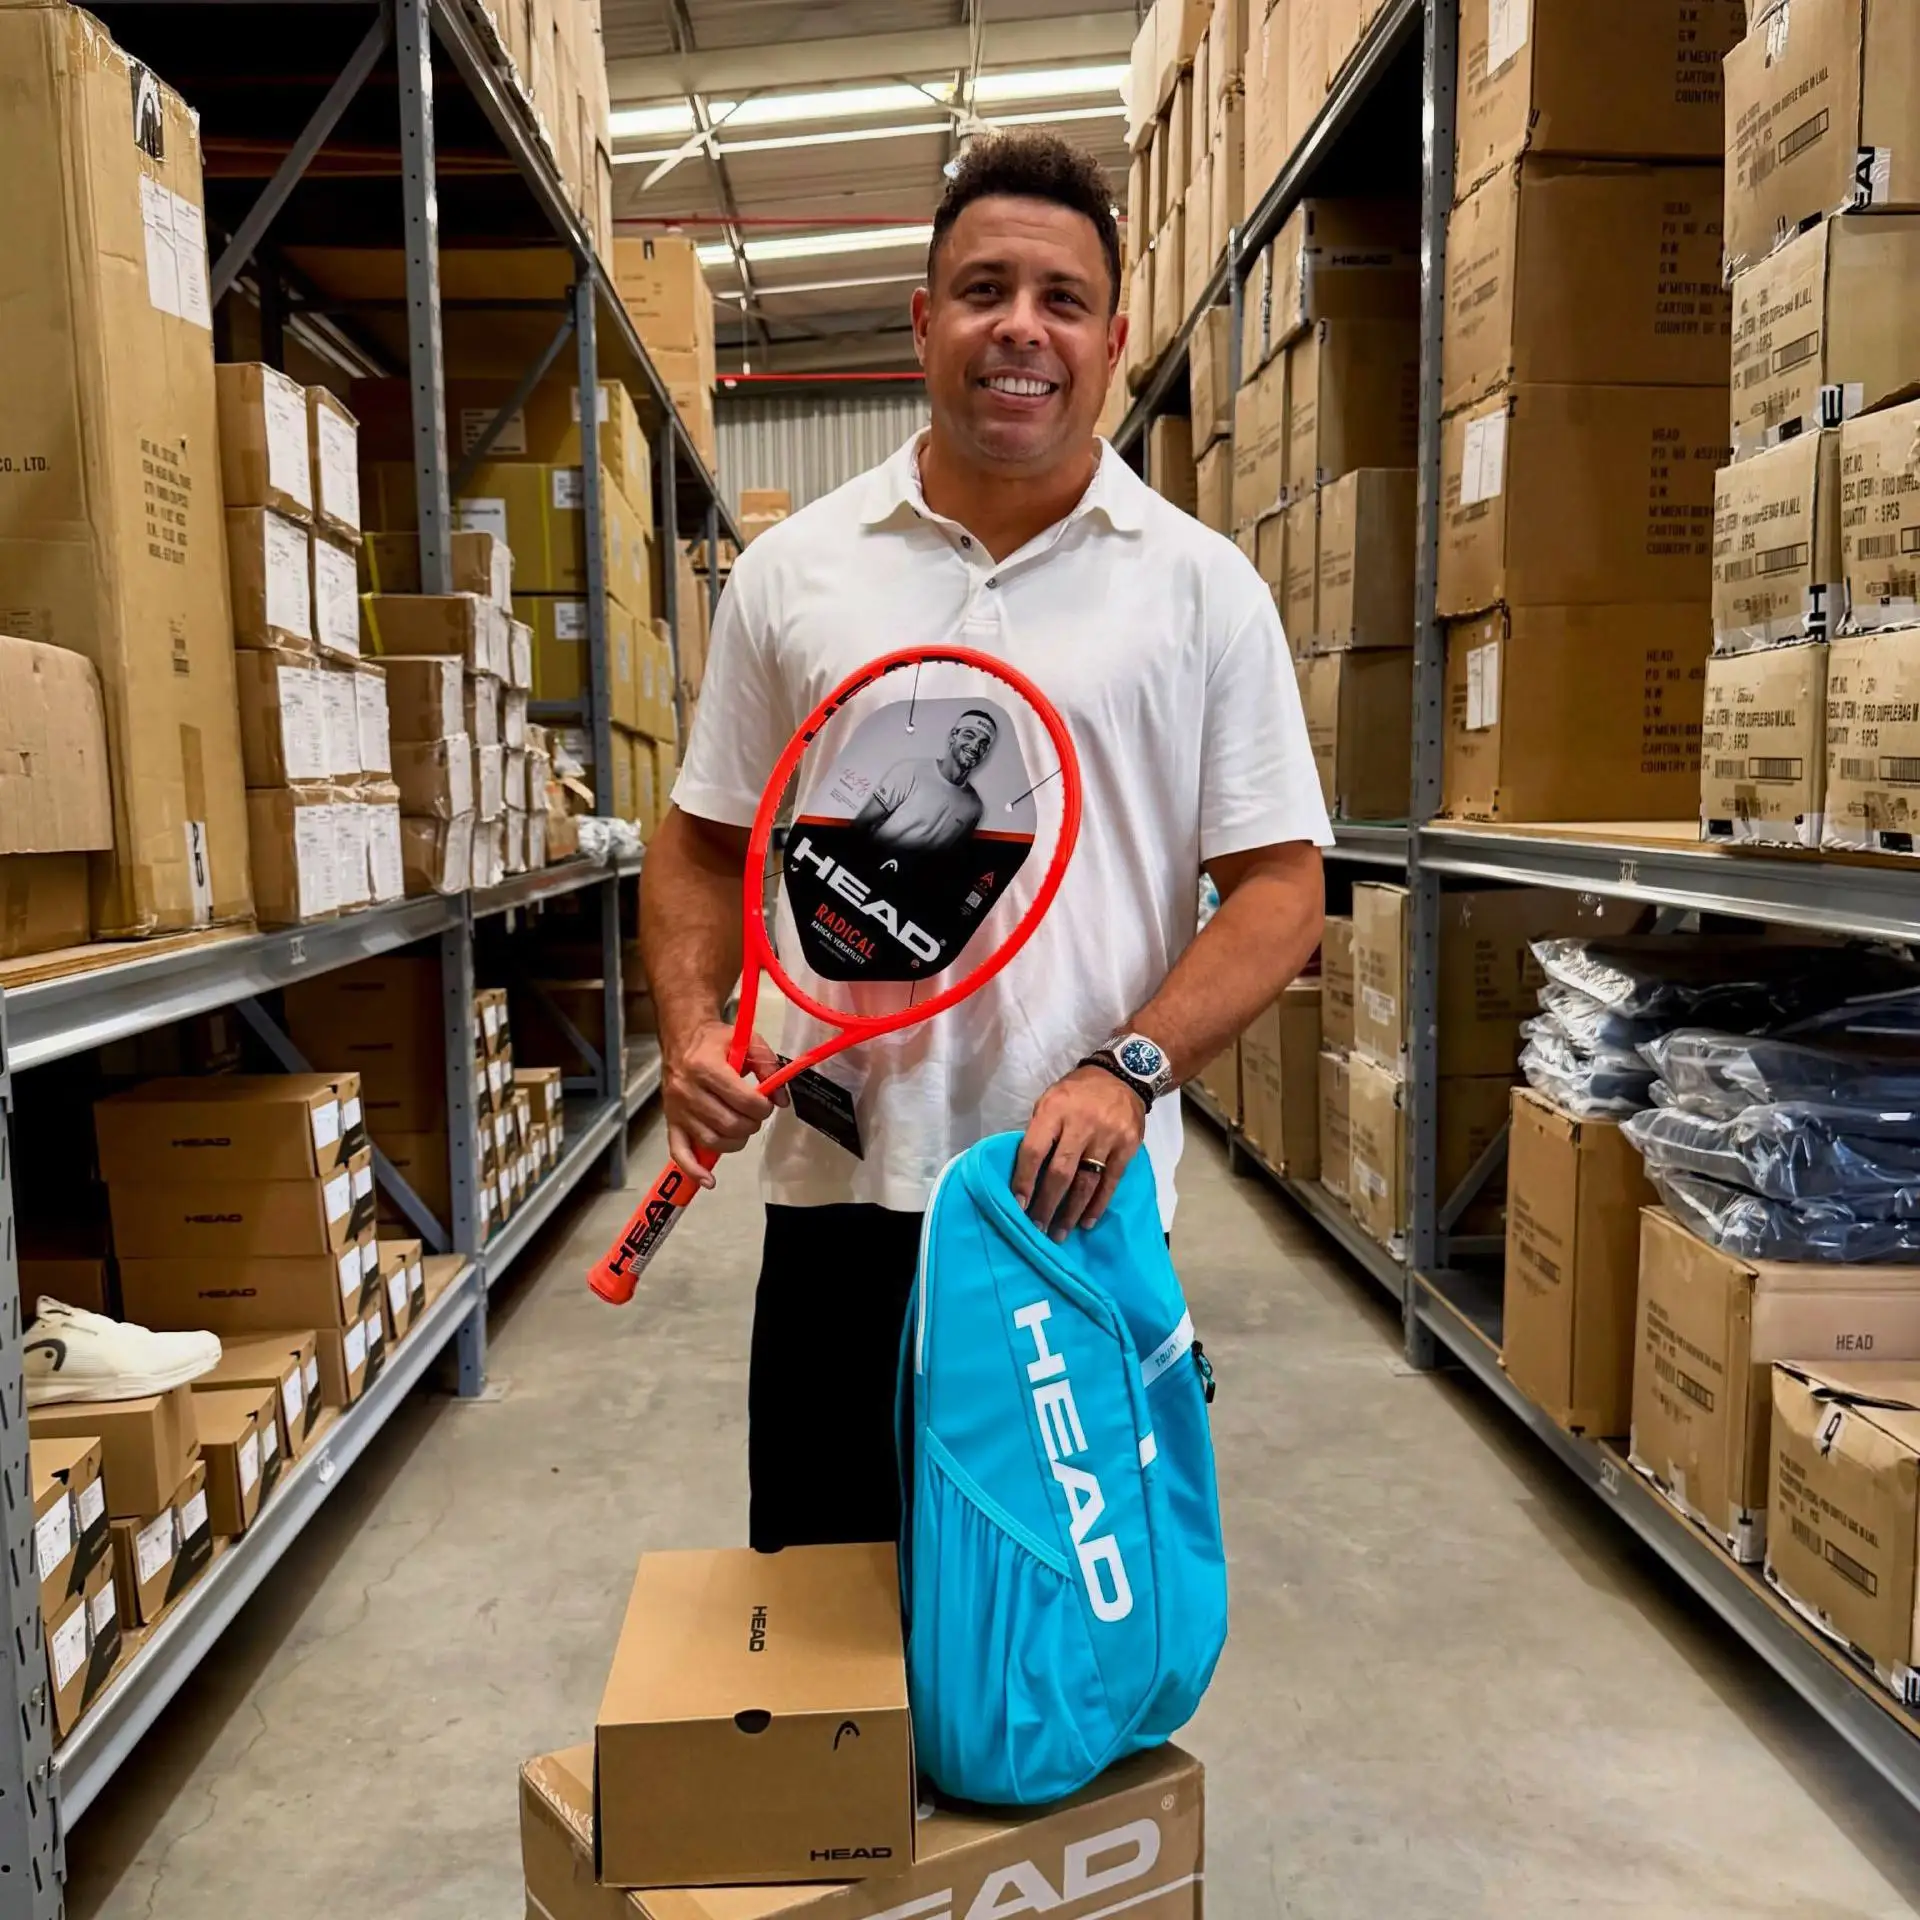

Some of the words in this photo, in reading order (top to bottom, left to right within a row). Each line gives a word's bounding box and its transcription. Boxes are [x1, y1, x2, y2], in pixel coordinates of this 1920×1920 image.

[1676, 70, 1716, 83] CARTON
[1675, 89, 1721, 103] COUNTRY
[1331, 253, 1392, 266] HEAD
[1656, 301, 1695, 315] CARTON
[1654, 321, 1698, 335] COUNTRY
[1652, 427, 1681, 441] HEAD
[24, 456, 50, 471] LTD.
[1646, 524, 1687, 537] CARTON
[1645, 542, 1692, 555] COUNTRY
[1645, 650, 1674, 662] HEAD
[1863, 704, 1876, 722] PRO
[1876, 704, 1898, 722] DUFFLE
[1898, 704, 1912, 721] BAG
[1641, 742, 1681, 756] CARTON
[1640, 760, 1686, 774] COUNTRY
[792, 837, 941, 962] HEAD
[815, 903, 876, 959] RADICAL
[810, 920, 834, 941] RADICAL
[833, 936, 866, 965] VERSATILITY
[171, 1137, 231, 1147] HEAD
[184, 1213, 243, 1223] HEAD
[608, 1169, 684, 1277] HEAD
[198, 1288, 257, 1298] HEAD
[1836, 1334, 1874, 1350] HEAD
[1013, 1299, 1134, 1622] HEAD
[749, 1605, 768, 1652] HEAD
[810, 1847, 893, 1862] HEAD
